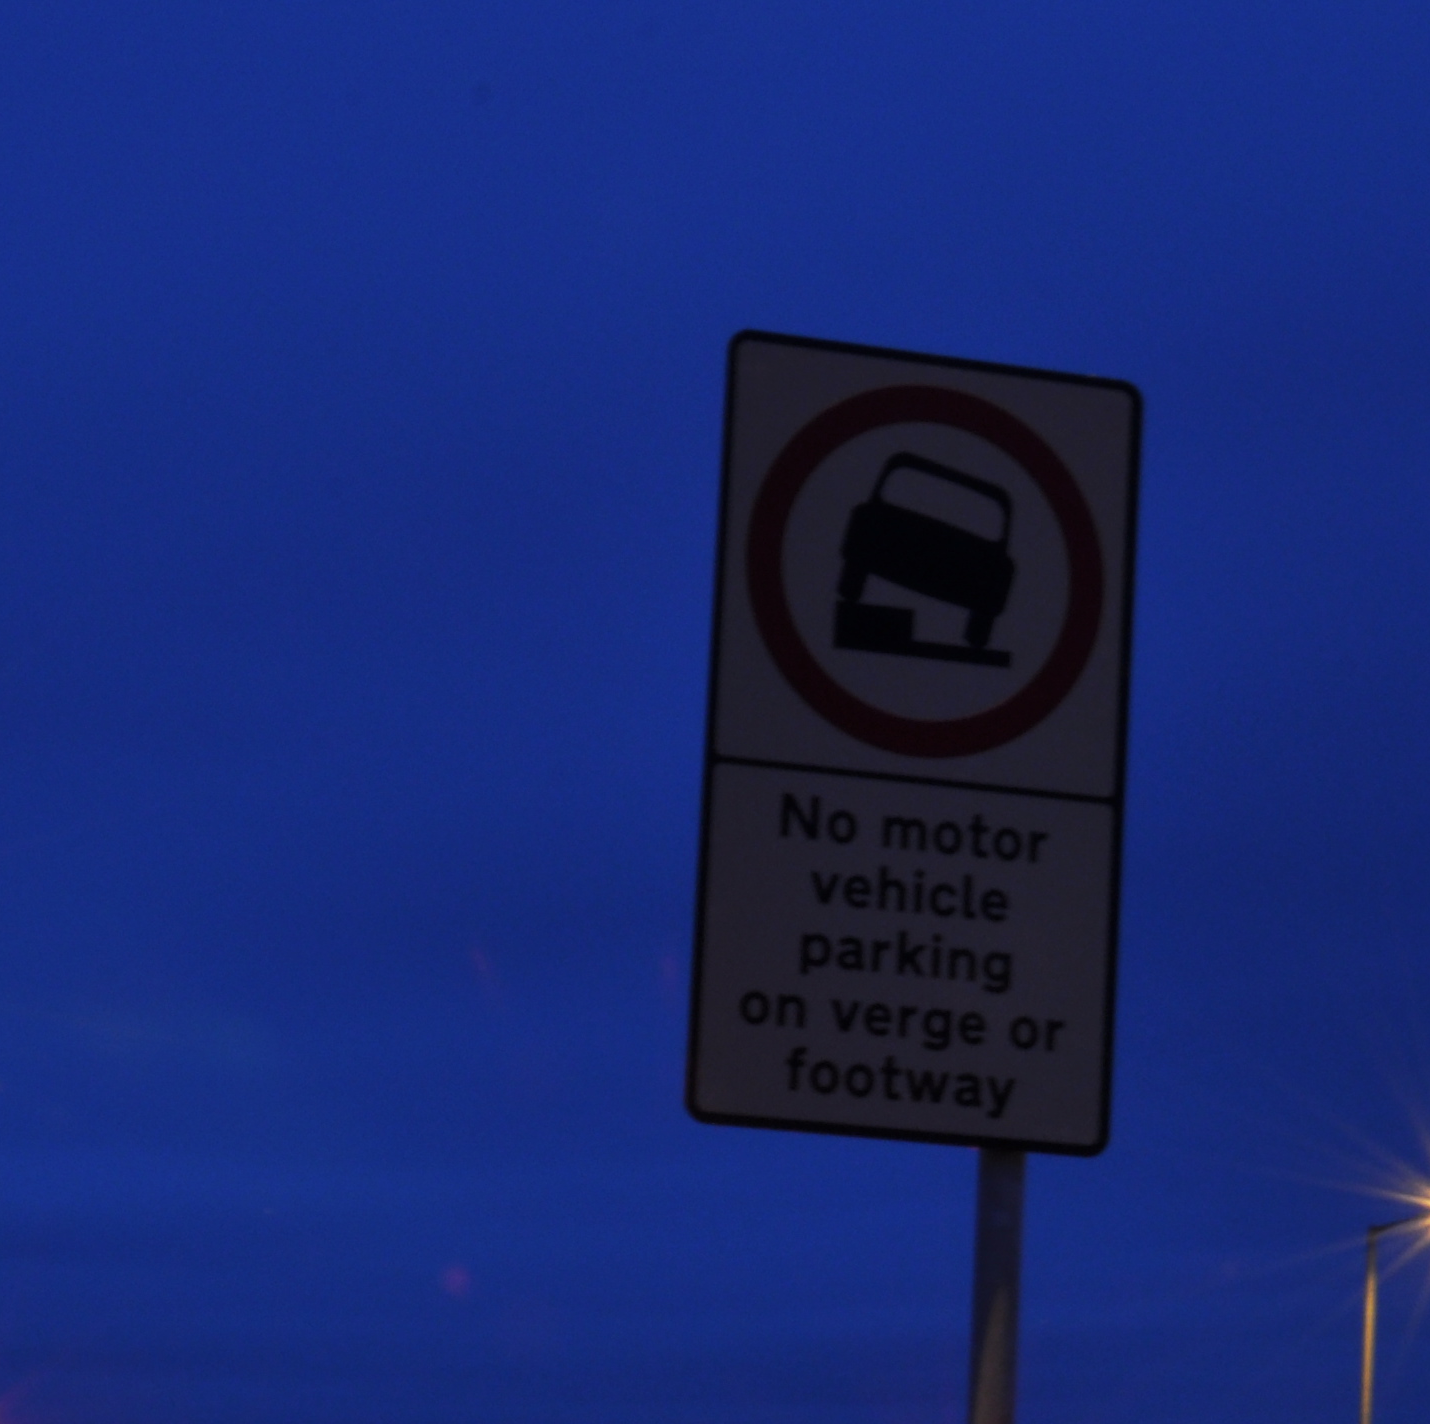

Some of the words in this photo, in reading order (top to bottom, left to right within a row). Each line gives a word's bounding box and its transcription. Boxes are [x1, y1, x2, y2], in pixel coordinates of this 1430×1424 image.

[779, 794, 857, 844] No
[881, 814, 1049, 863] motor
[812, 866, 1010, 923] vehicle
[799, 931, 1011, 993] parking
[739, 990, 806, 1028] on
[831, 998, 986, 1051] verge
[1009, 1016, 1064, 1051] or
[786, 1046, 1015, 1119] footway
